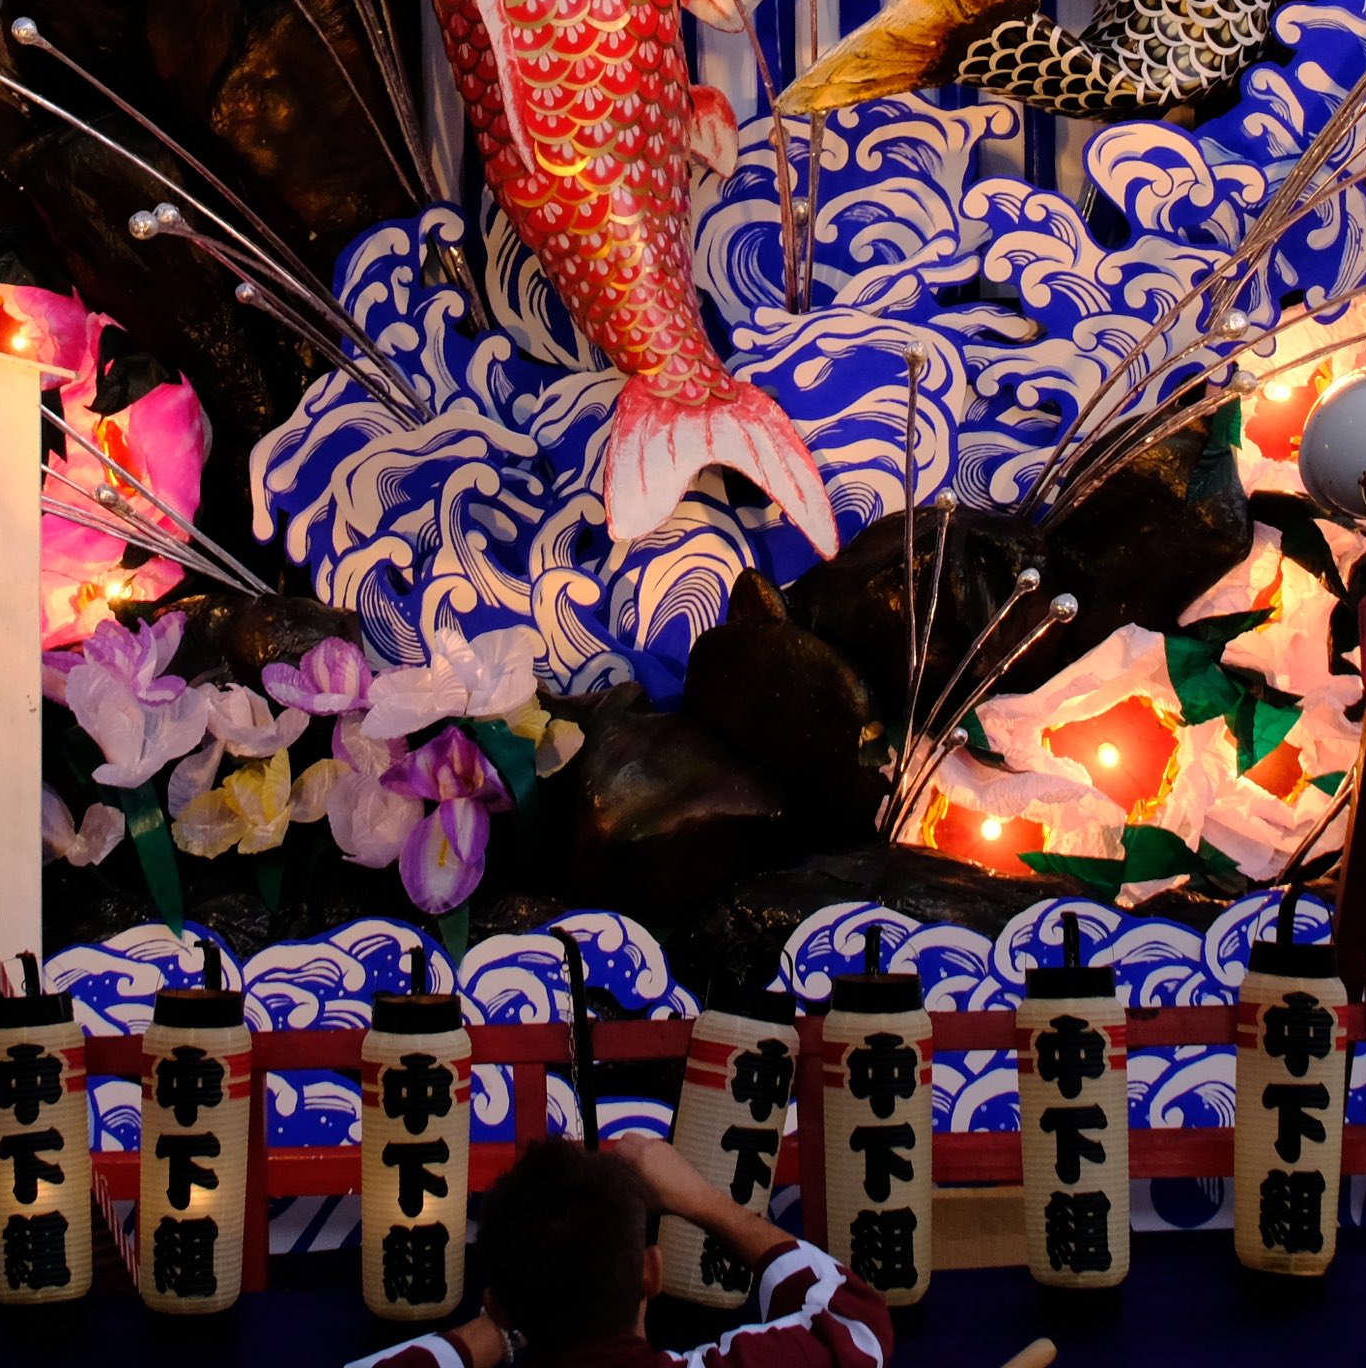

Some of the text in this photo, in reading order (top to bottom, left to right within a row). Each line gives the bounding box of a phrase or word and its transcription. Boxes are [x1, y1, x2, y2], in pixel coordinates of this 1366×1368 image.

[153, 1045, 225, 1298] 中下組
[381, 1053, 454, 1306] 中下組
[846, 1032, 918, 1290] 中下組
[1035, 1014, 1112, 1274] 中下組
[1262, 991, 1334, 1254] 中下組
